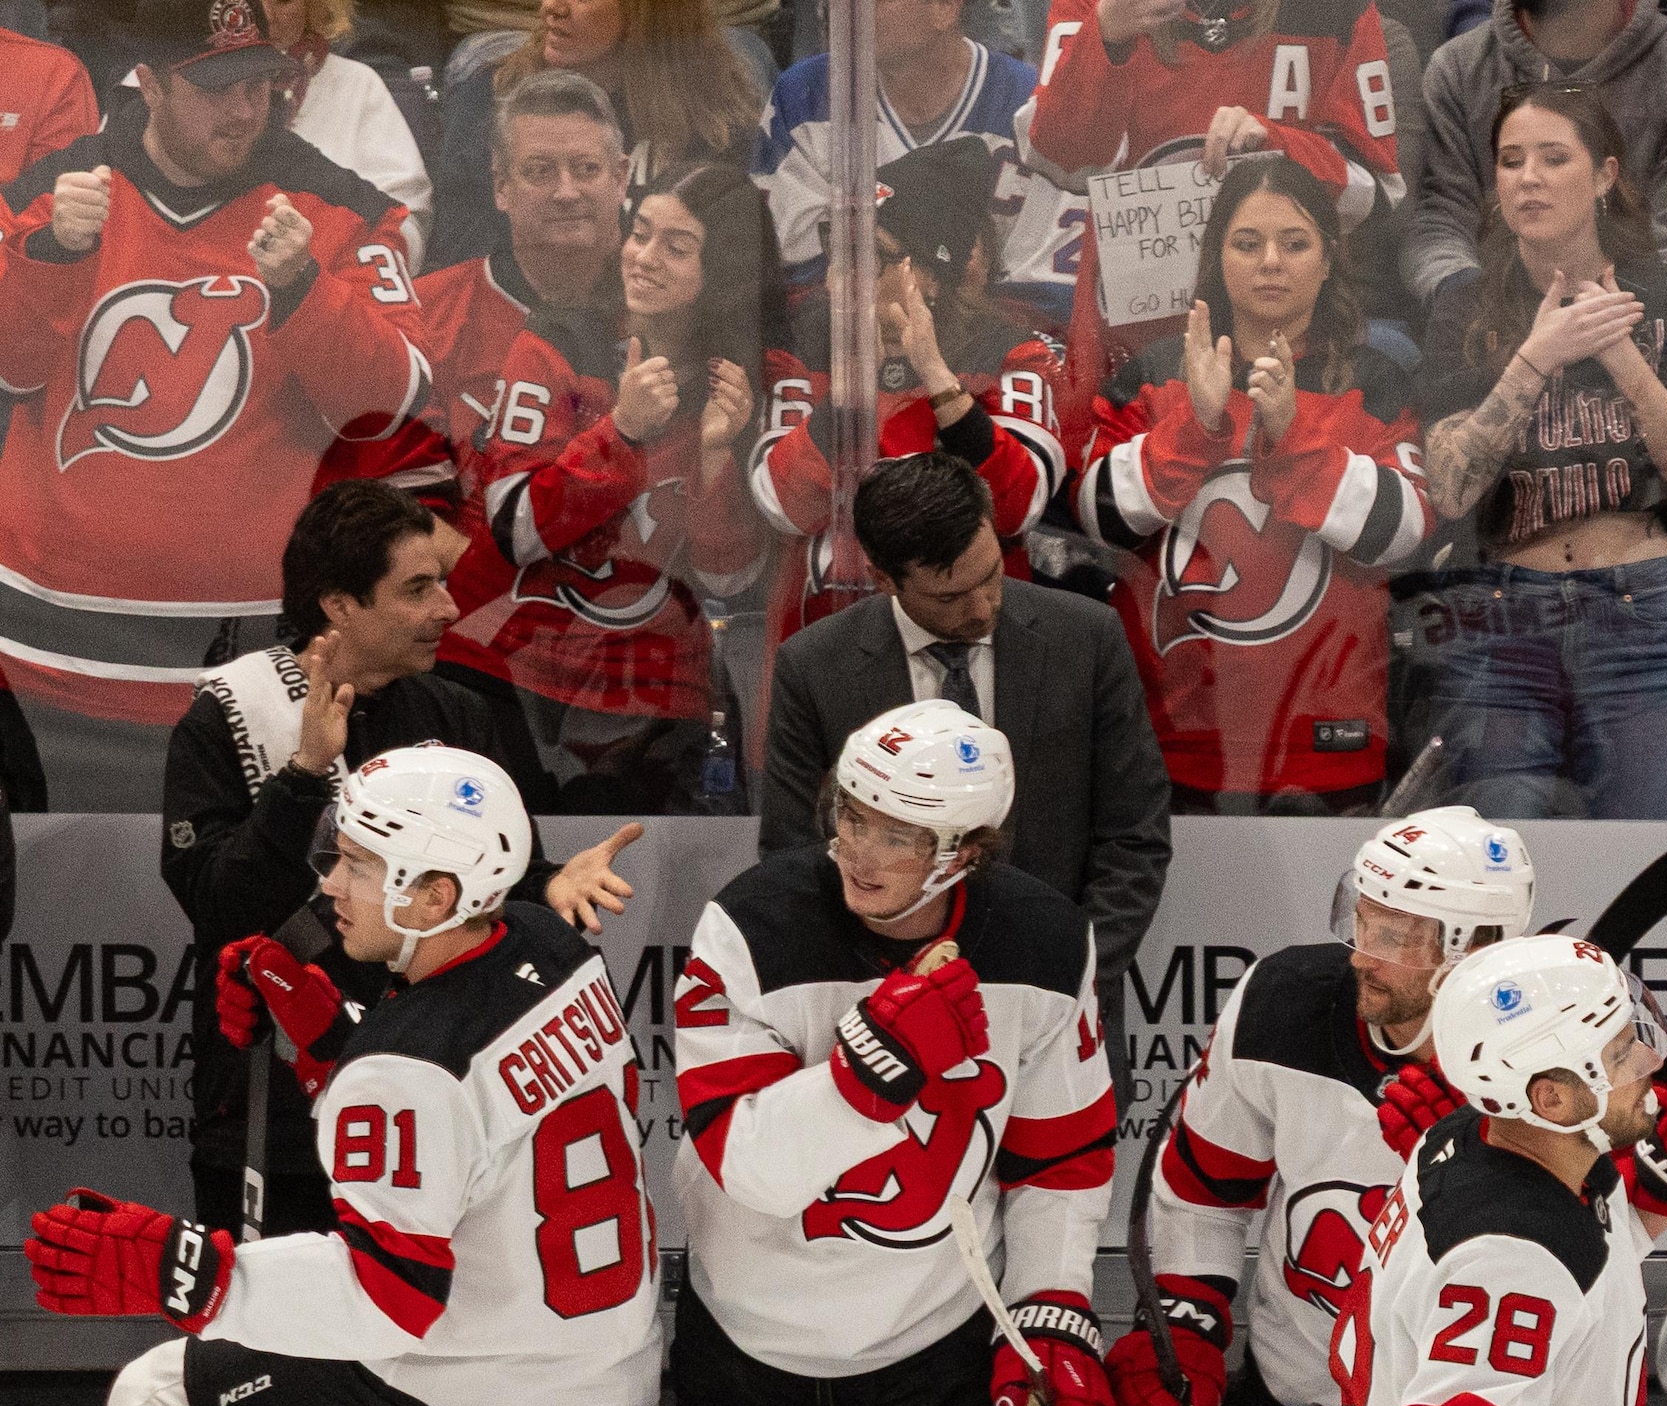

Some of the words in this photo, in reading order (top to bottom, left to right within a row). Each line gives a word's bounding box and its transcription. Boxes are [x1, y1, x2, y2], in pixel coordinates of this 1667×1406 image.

[1267, 44, 1312, 120] A
[1093, 168, 1175, 200] TELL
[1096, 203, 1162, 241] HAPPY
[1138, 235, 1179, 260] FOR
[1129, 294, 1160, 315] GO
[1361, 858, 1395, 881] CCM
[0, 943, 197, 1024] MBA
[1496, 1003, 1533, 1025] Prudential
[14, 1114, 84, 1146] way
[97, 1113, 130, 1139] to
[332, 1104, 422, 1190] 81
[1428, 1283, 1557, 1380] 28
